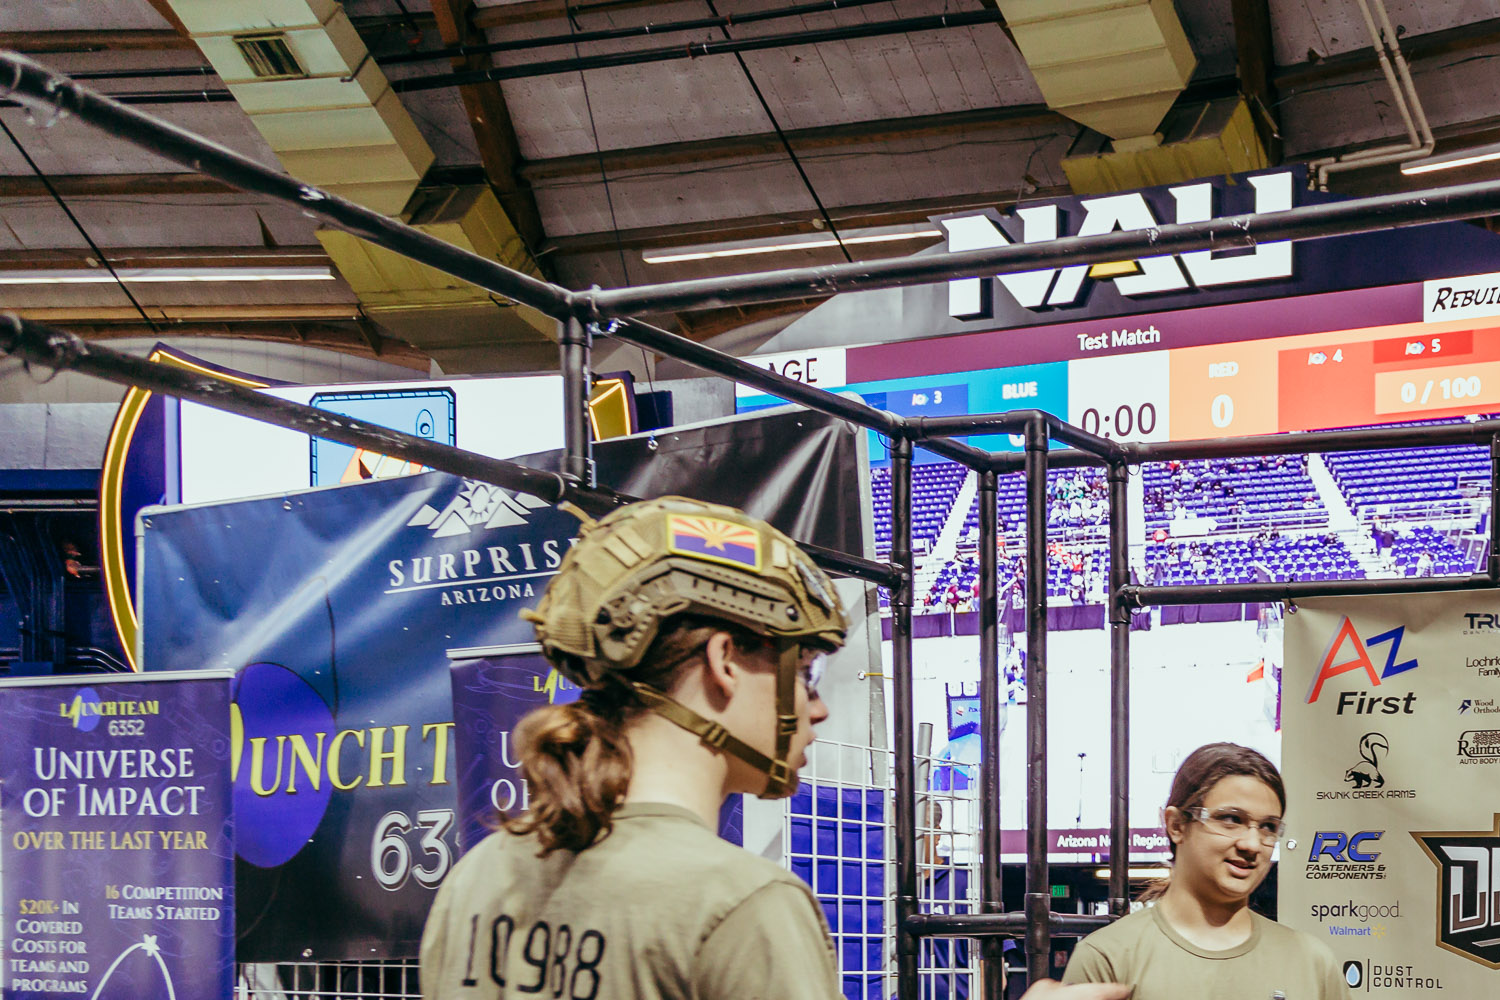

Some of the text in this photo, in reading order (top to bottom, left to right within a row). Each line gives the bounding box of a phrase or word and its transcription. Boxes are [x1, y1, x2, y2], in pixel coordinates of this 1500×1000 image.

[1077, 326, 1160, 351] Test Match
[1431, 338, 1441, 353] 5
[1332, 348, 1344, 363] 4
[1208, 361, 1239, 378] RED
[934, 391, 943, 404] 3
[1002, 381, 1038, 399] BLUE
[1401, 375, 1483, 404] 0 / 100
[1211, 394, 1234, 428] 0
[1081, 402, 1157, 438] 0:00
[388, 537, 580, 587] SURPRIS
[441, 582, 535, 606] ARIZONA
[1336, 691, 1417, 715] First
[1474, 698, 1494, 706] Wood
[108, 719, 145, 736] 6352
[34, 747, 194, 780] UNIVERSE
[1479, 757, 1498, 765] BODY
[23, 783, 205, 817] OF IMPACT
[1316, 790, 1416, 800] SKUNK CREEK ARMS
[13, 830, 208, 850] OVER THE LAST YEAR
[1056, 834, 1098, 848] Arizona
[1308, 830, 1386, 862] RC
[371, 808, 462, 891] 63
[1306, 864, 1386, 872] FASTENERS &
[1306, 872, 1382, 880] COMPONENTS
[105, 885, 223, 900] 16 COMPETITION
[1052, 885, 1066, 897] EXIT
[62, 900, 79, 914] IN
[107, 904, 220, 921] TEAMS STARTED
[1311, 900, 1399, 922] sparkgood
[16, 918, 83, 935] COVERED
[1328, 925, 1371, 936] Walmart
[12, 938, 88, 954] COSTS FOR
[10, 959, 90, 974] TEAMS AND
[1373, 965, 1414, 976] DUST
[12, 978, 88, 993] PROGRAMS
[1373, 977, 1444, 990] CONTROL
